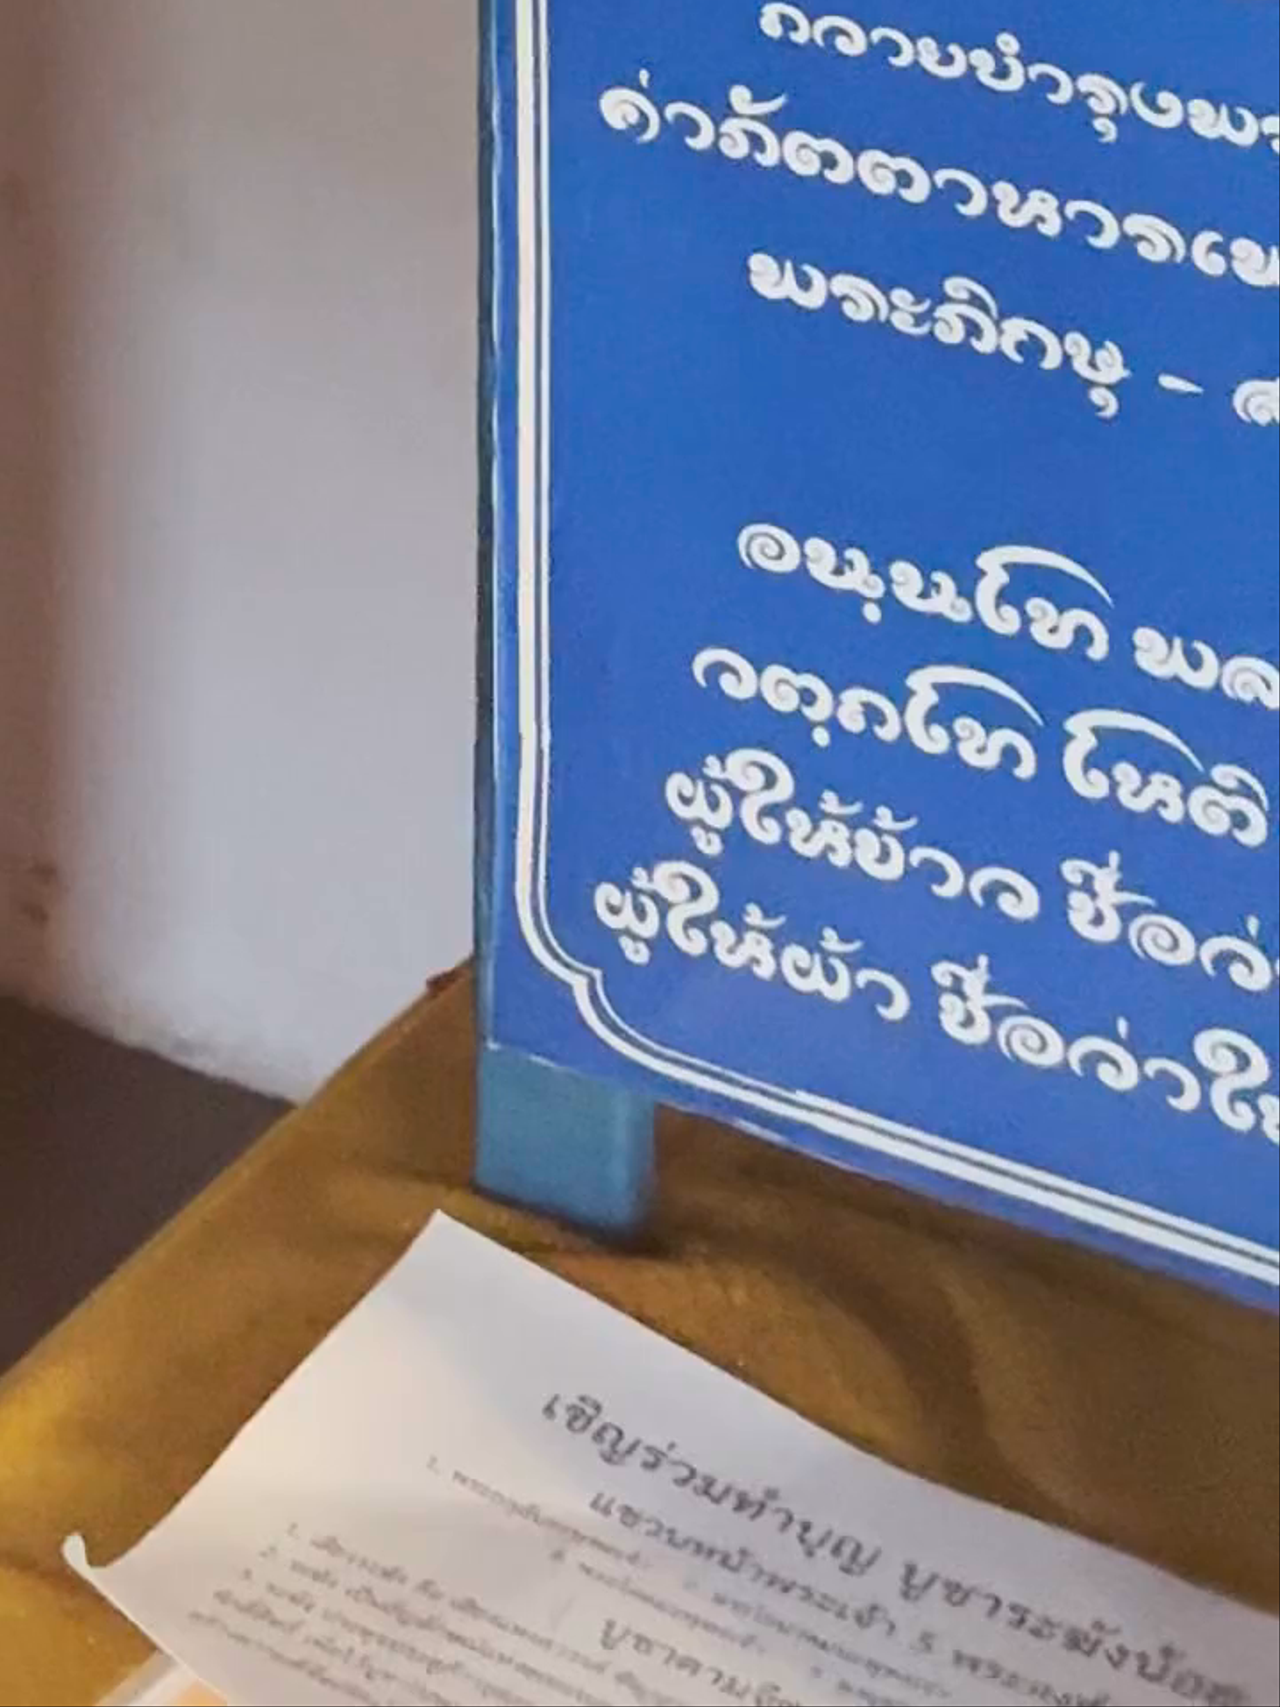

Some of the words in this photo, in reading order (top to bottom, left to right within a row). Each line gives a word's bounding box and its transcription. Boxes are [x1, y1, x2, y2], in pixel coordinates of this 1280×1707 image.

[749, 254, 1129, 417] พระภิกษุ
[1062, 709, 1269, 848] โหติ
[595, 860, 911, 1021] ผู้ให้ผ้า
[666, 748, 1040, 921] ผู้ให้ข้าว
[1061, 850, 1280, 991] ชื่อว่
[541, 1392, 883, 1577] เชิญร่วมทำบุญ
